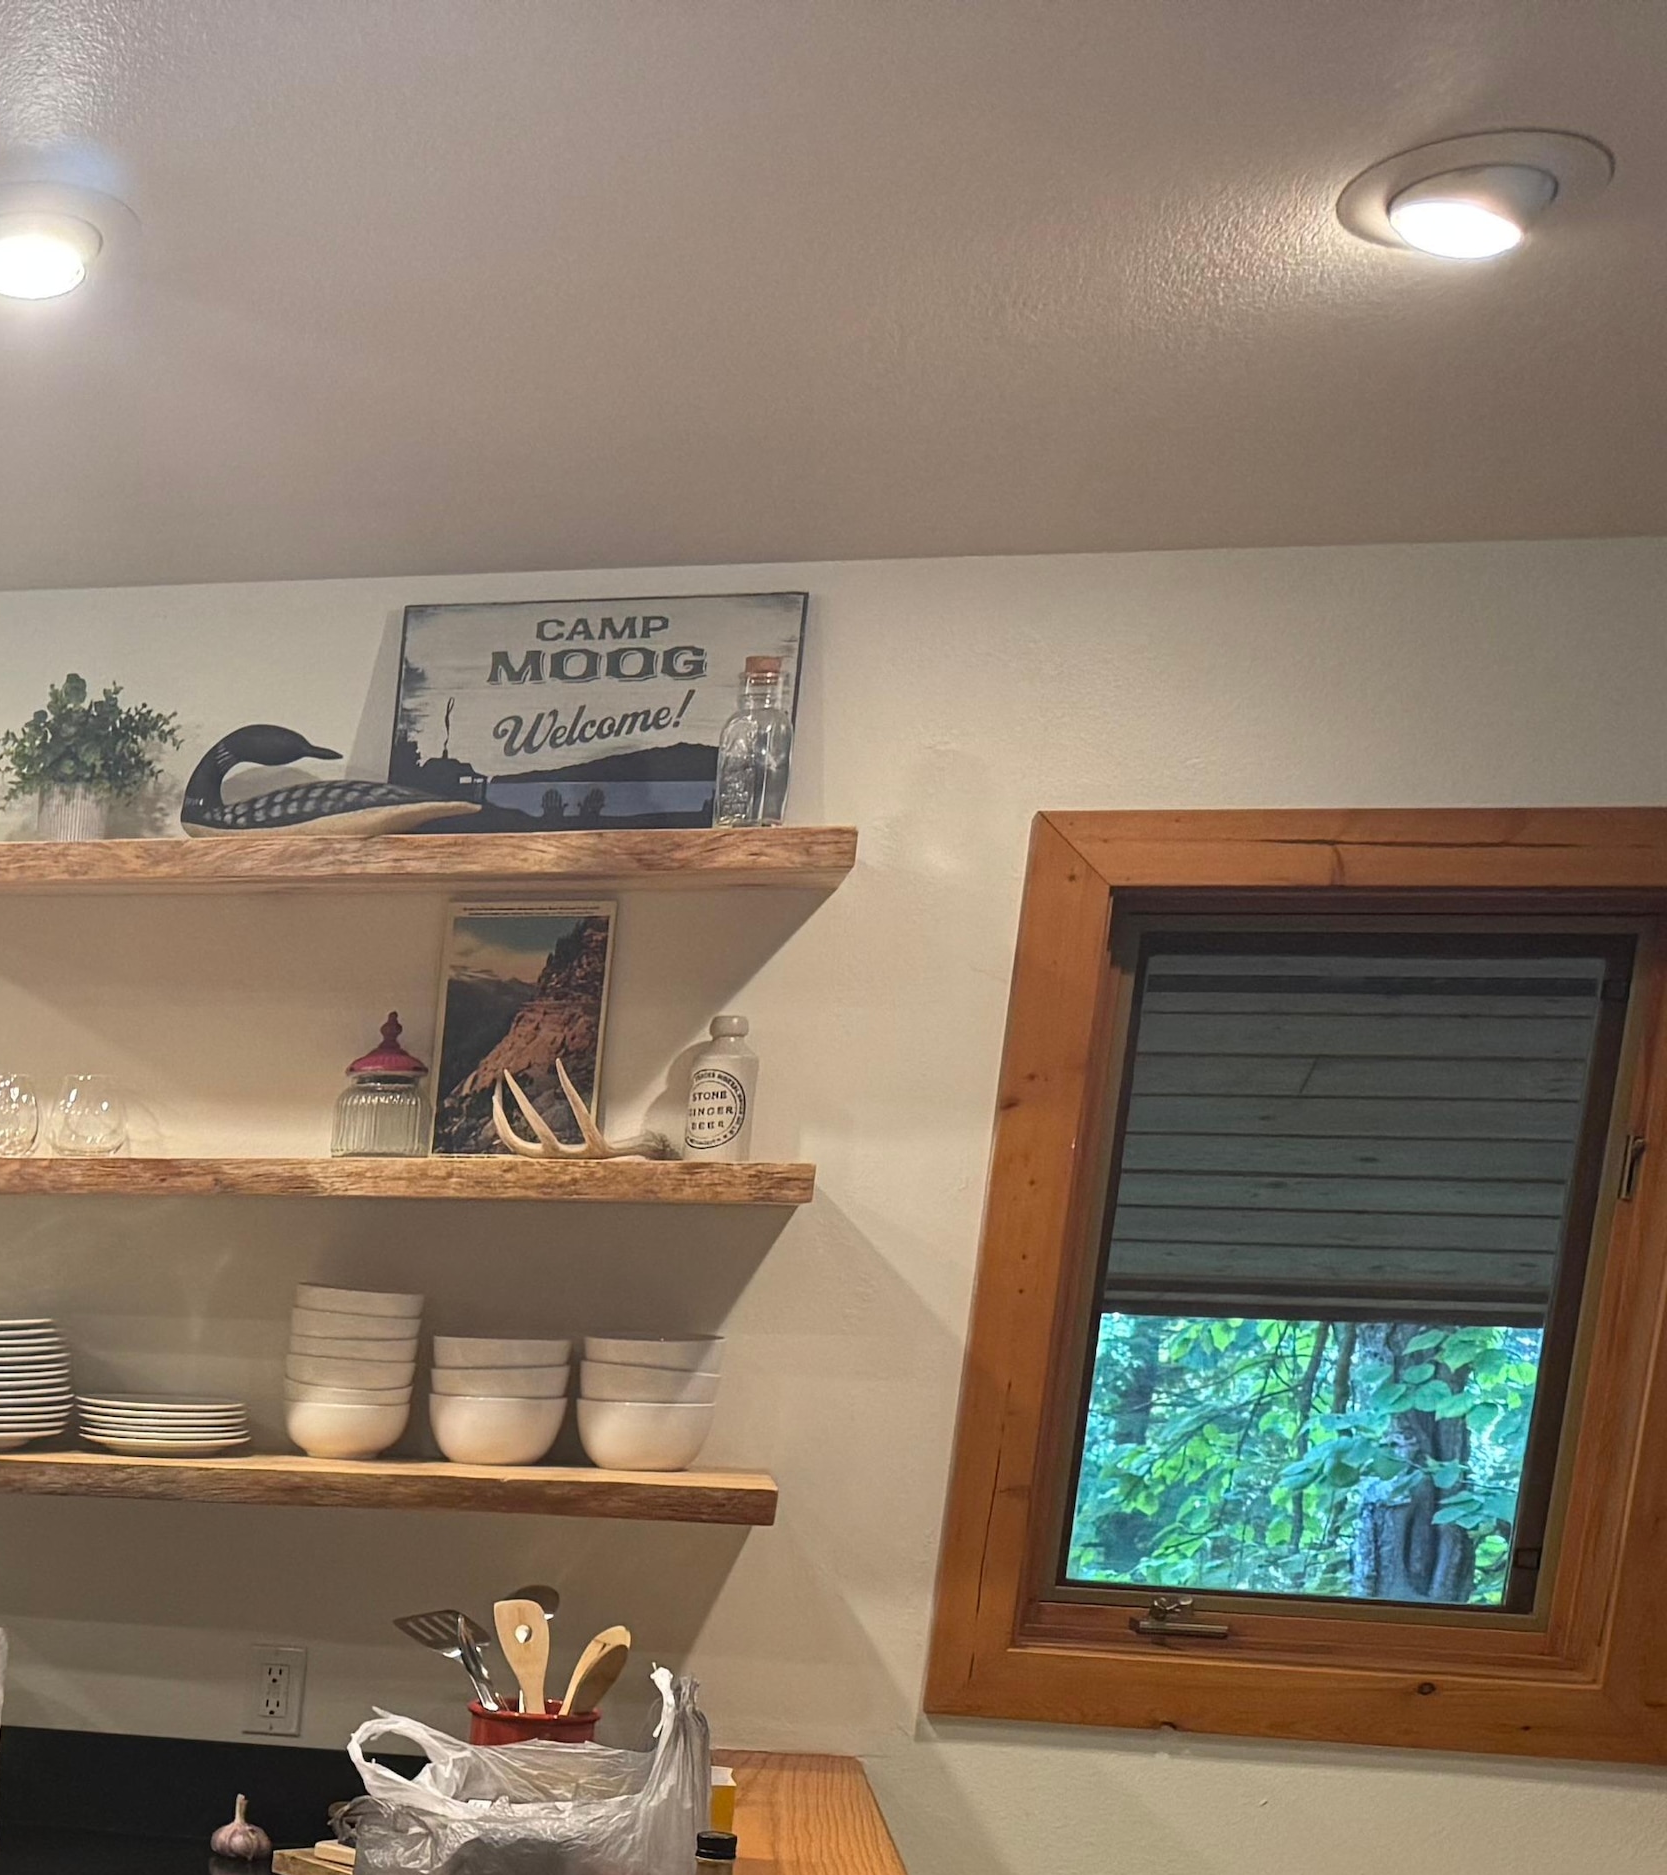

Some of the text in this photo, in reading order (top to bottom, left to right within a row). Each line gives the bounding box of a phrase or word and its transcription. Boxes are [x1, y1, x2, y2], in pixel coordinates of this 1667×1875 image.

[536, 616, 669, 641] CAMP
[487, 646, 707, 684] MOOG
[492, 689, 696, 757] Welcome!
[692, 1091, 727, 1102] STONE
[691, 1121, 724, 1131] BEER
